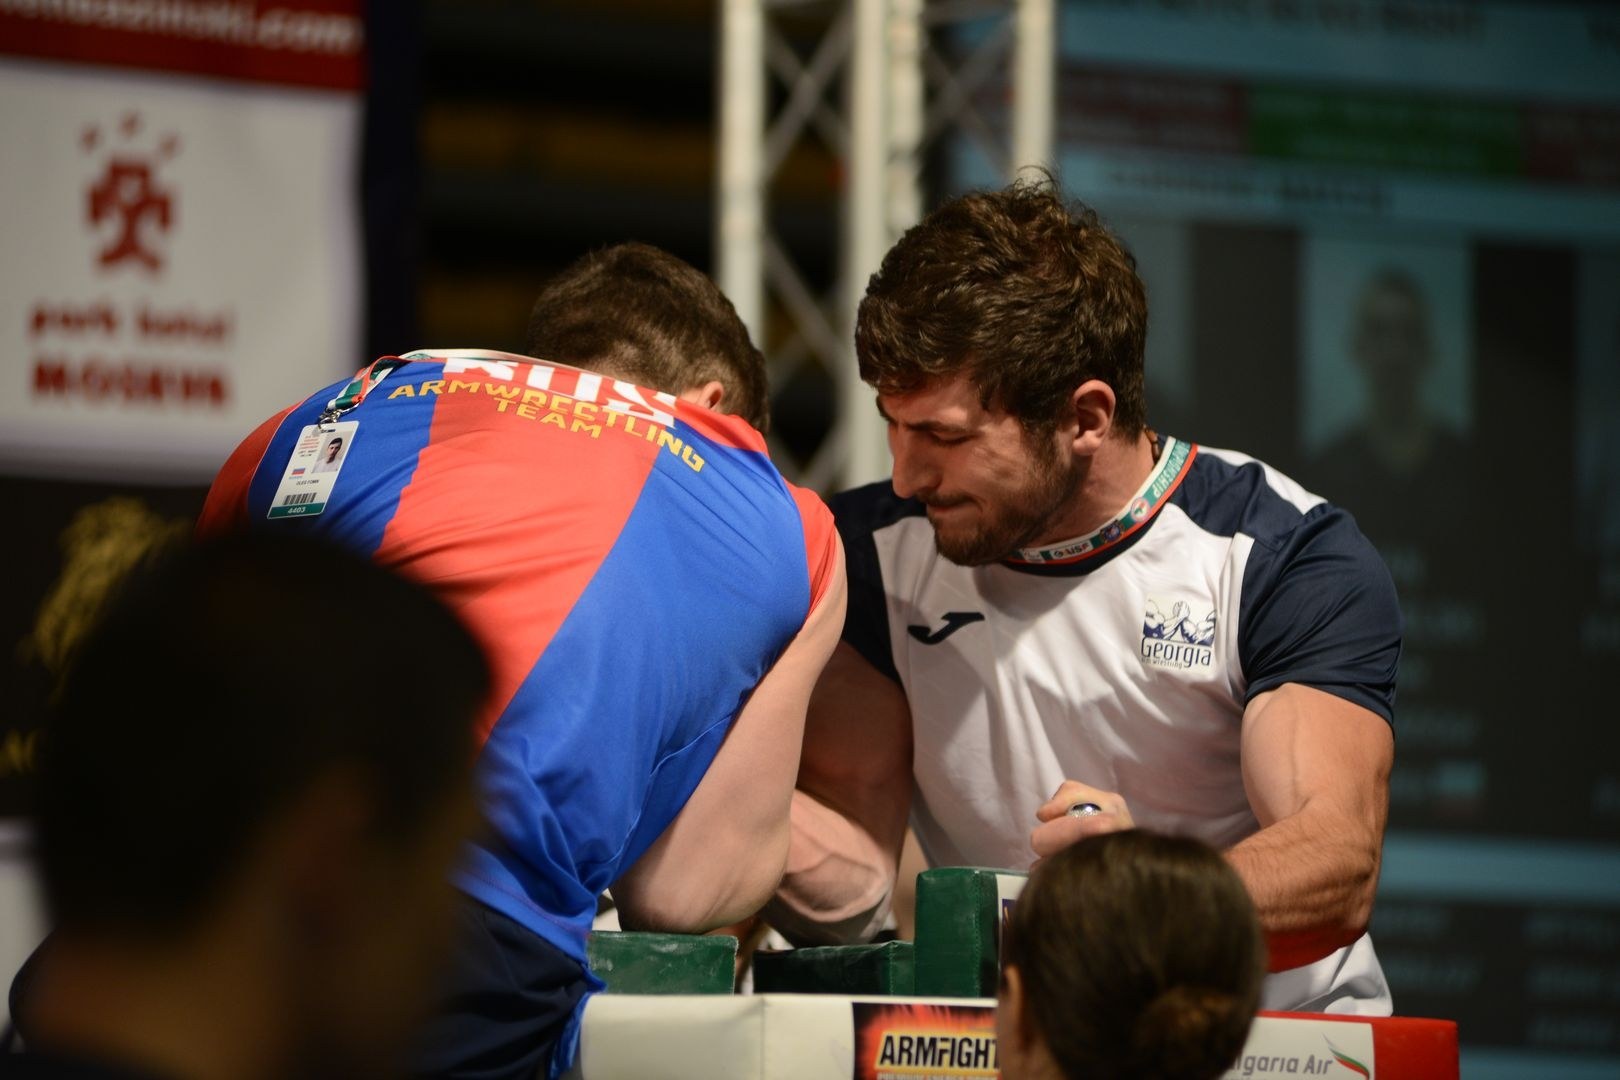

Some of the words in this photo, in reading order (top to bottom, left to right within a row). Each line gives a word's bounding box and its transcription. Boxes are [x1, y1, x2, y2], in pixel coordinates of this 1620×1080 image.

[387, 379, 705, 473] ARMWRESTLING
[493, 397, 602, 440] TEAM
[1141, 636, 1211, 668] Georgia
[1303, 1054, 1333, 1075] Air
